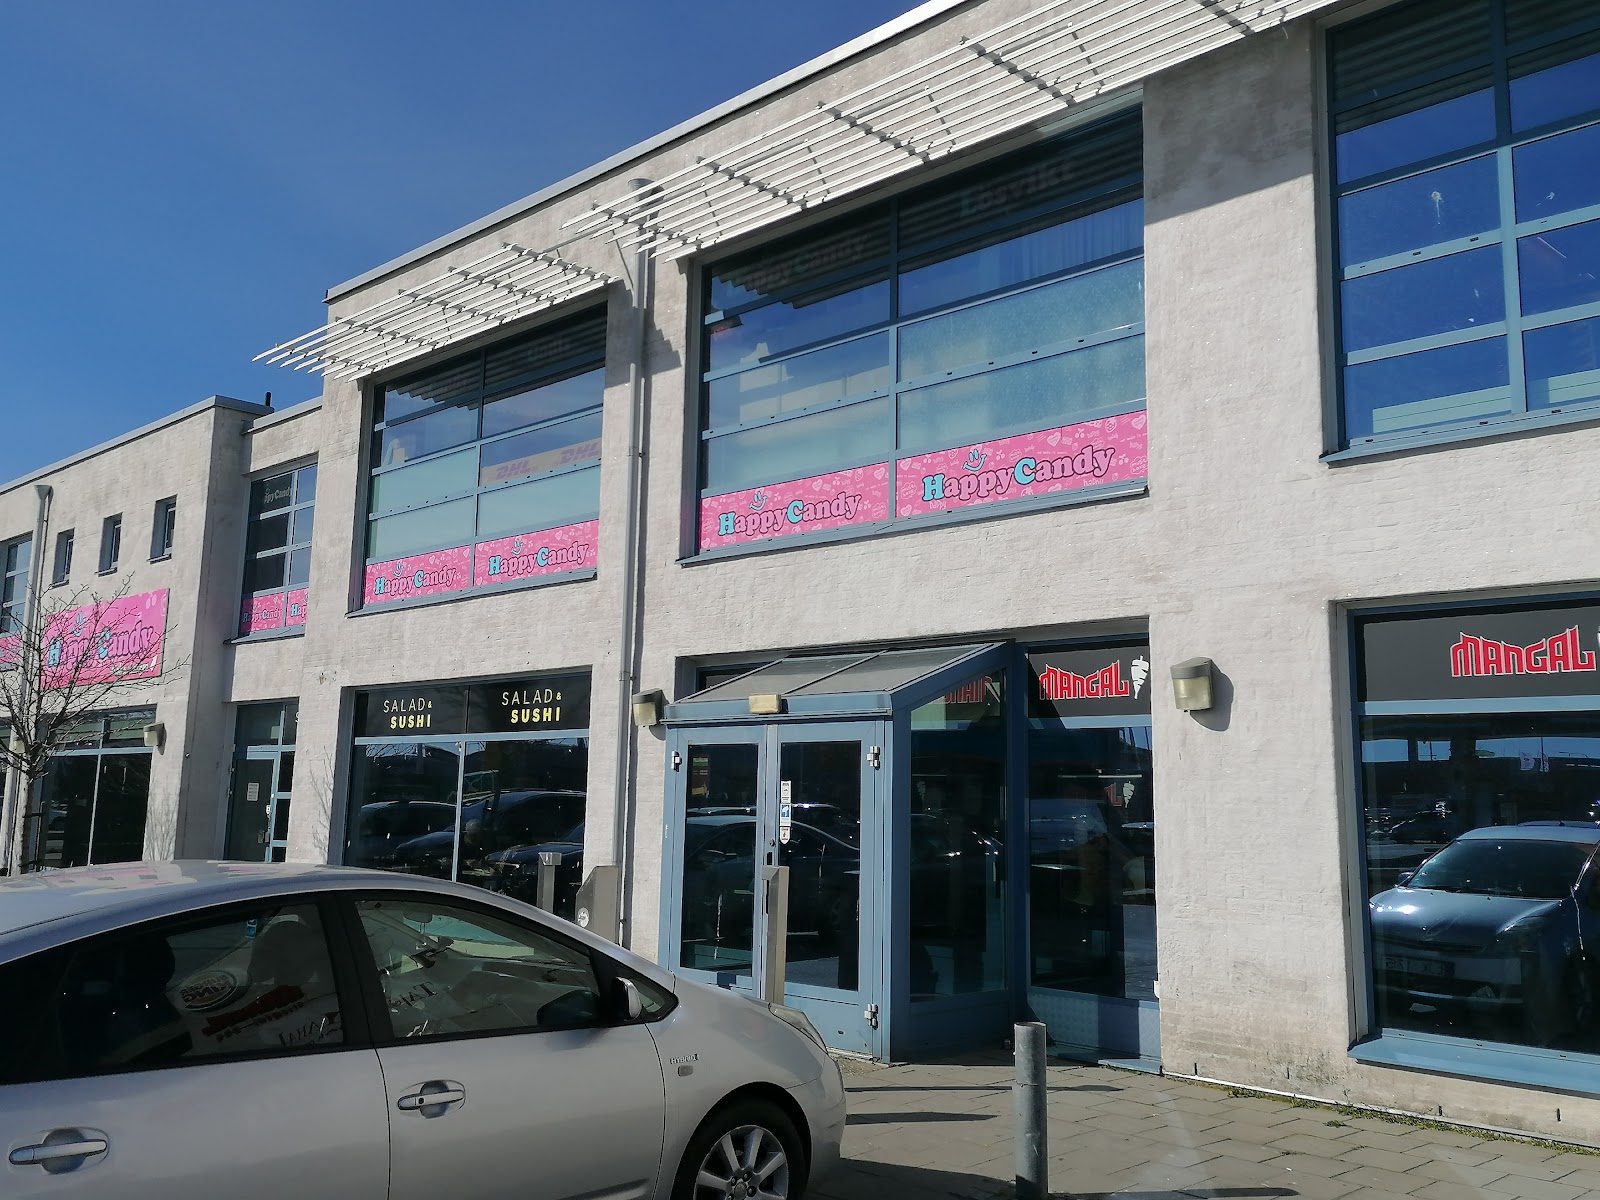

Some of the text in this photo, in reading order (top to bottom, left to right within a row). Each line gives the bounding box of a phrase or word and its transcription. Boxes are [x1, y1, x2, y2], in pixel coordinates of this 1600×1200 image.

[560, 443, 599, 465] DHL
[496, 460, 530, 480] DHL
[922, 445, 1115, 501] HappyCandy
[718, 491, 862, 537] HappyCandy
[488, 541, 589, 576] HappyCandy
[374, 565, 456, 596] HappyCandy
[1450, 625, 1596, 677] MANGAL
[1039, 660, 1129, 700] MANGAL
[383, 697, 425, 713] SALAD
[501, 688, 553, 706] SALAD
[390, 714, 431, 729] SUSHI
[510, 706, 561, 724] SUSHI
